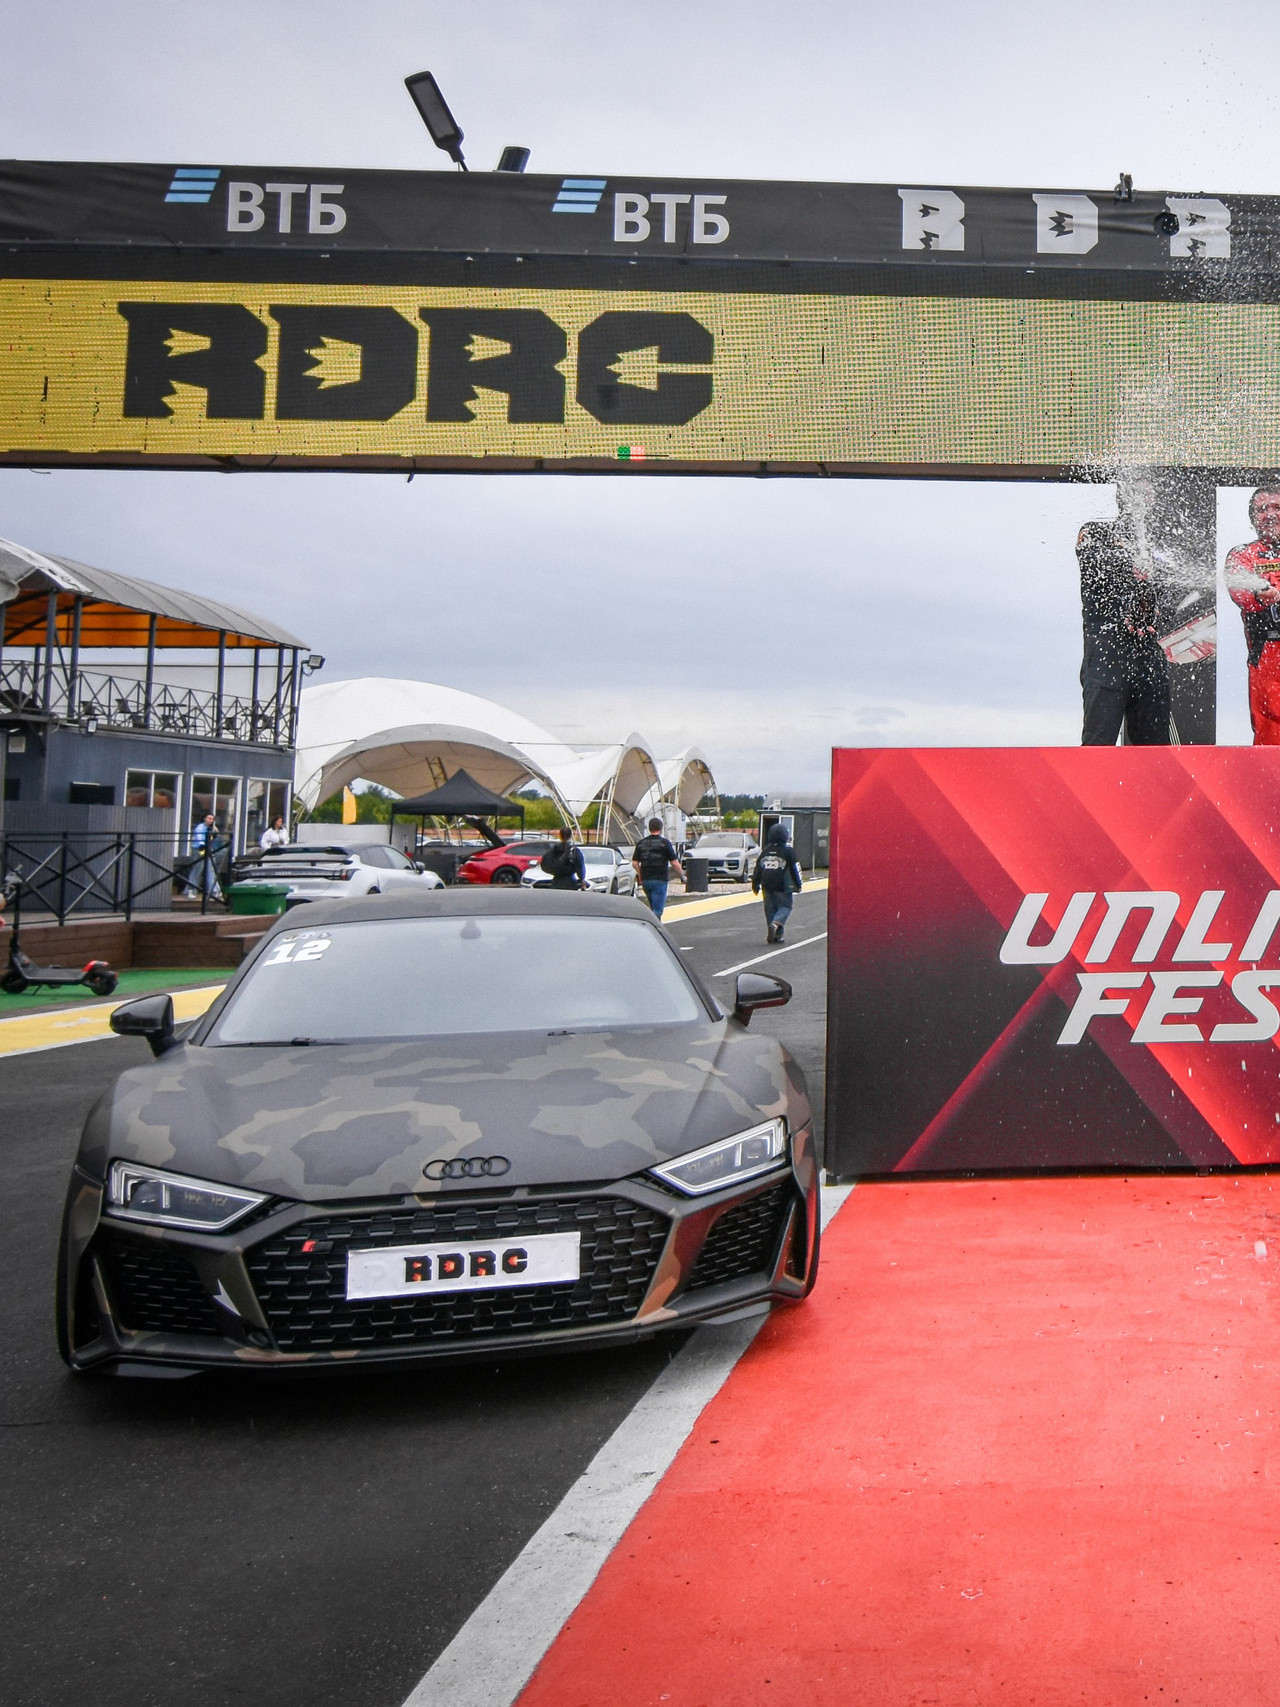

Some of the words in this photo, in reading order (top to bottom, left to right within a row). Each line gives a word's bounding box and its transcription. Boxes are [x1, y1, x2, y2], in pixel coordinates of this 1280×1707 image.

[226, 181, 347, 234] ВТБ
[613, 194, 731, 244] ВТБ
[117, 301, 714, 426] RDRC
[263, 939, 332, 967] 12
[404, 1247, 528, 1283] RDRC
